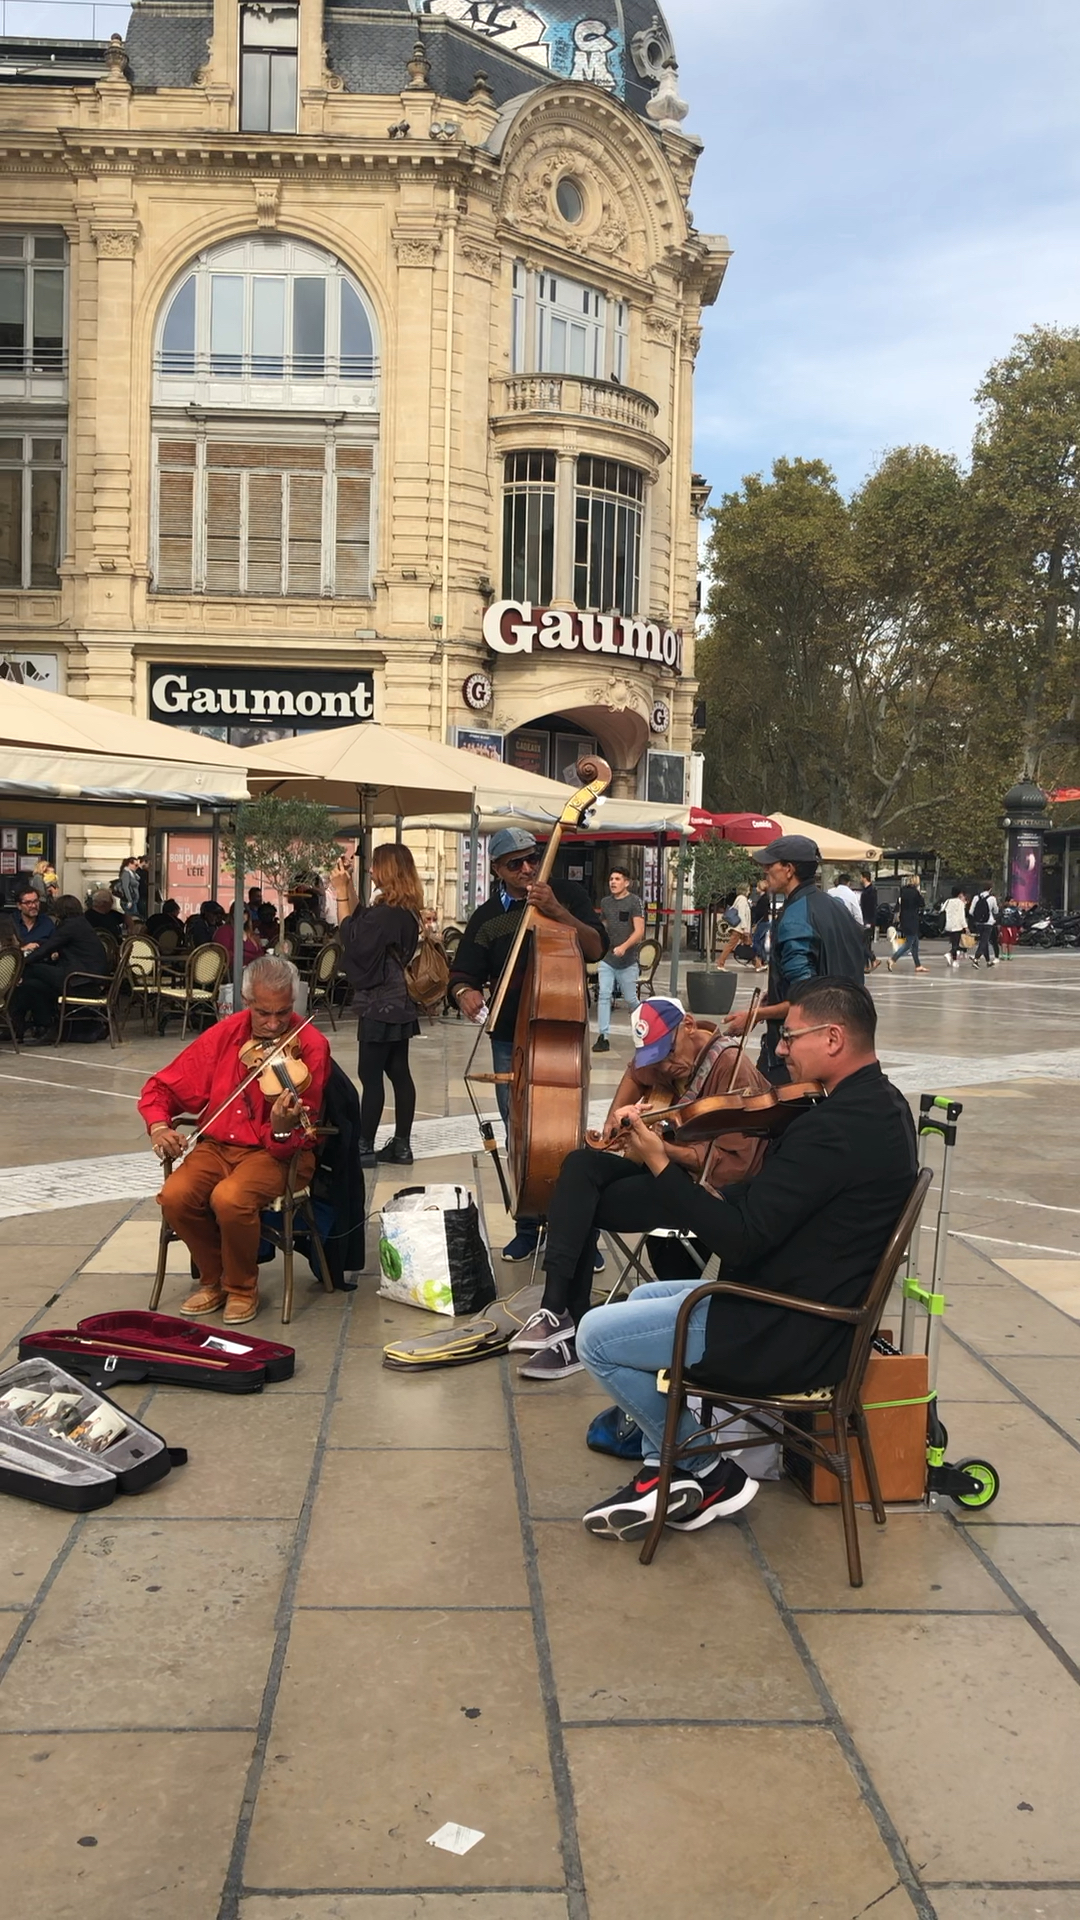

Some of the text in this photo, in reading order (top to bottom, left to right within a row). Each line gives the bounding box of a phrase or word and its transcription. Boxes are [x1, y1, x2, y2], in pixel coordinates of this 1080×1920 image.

[152, 675, 373, 717] Gaumont
[472, 683, 486, 701] G
[653, 709, 666, 725] G
[169, 853, 184, 863] BON
[185, 854, 209, 867] PLAN
[187, 867, 204, 877] L'ÉTÉ
[184, 903, 201, 915] PLA
